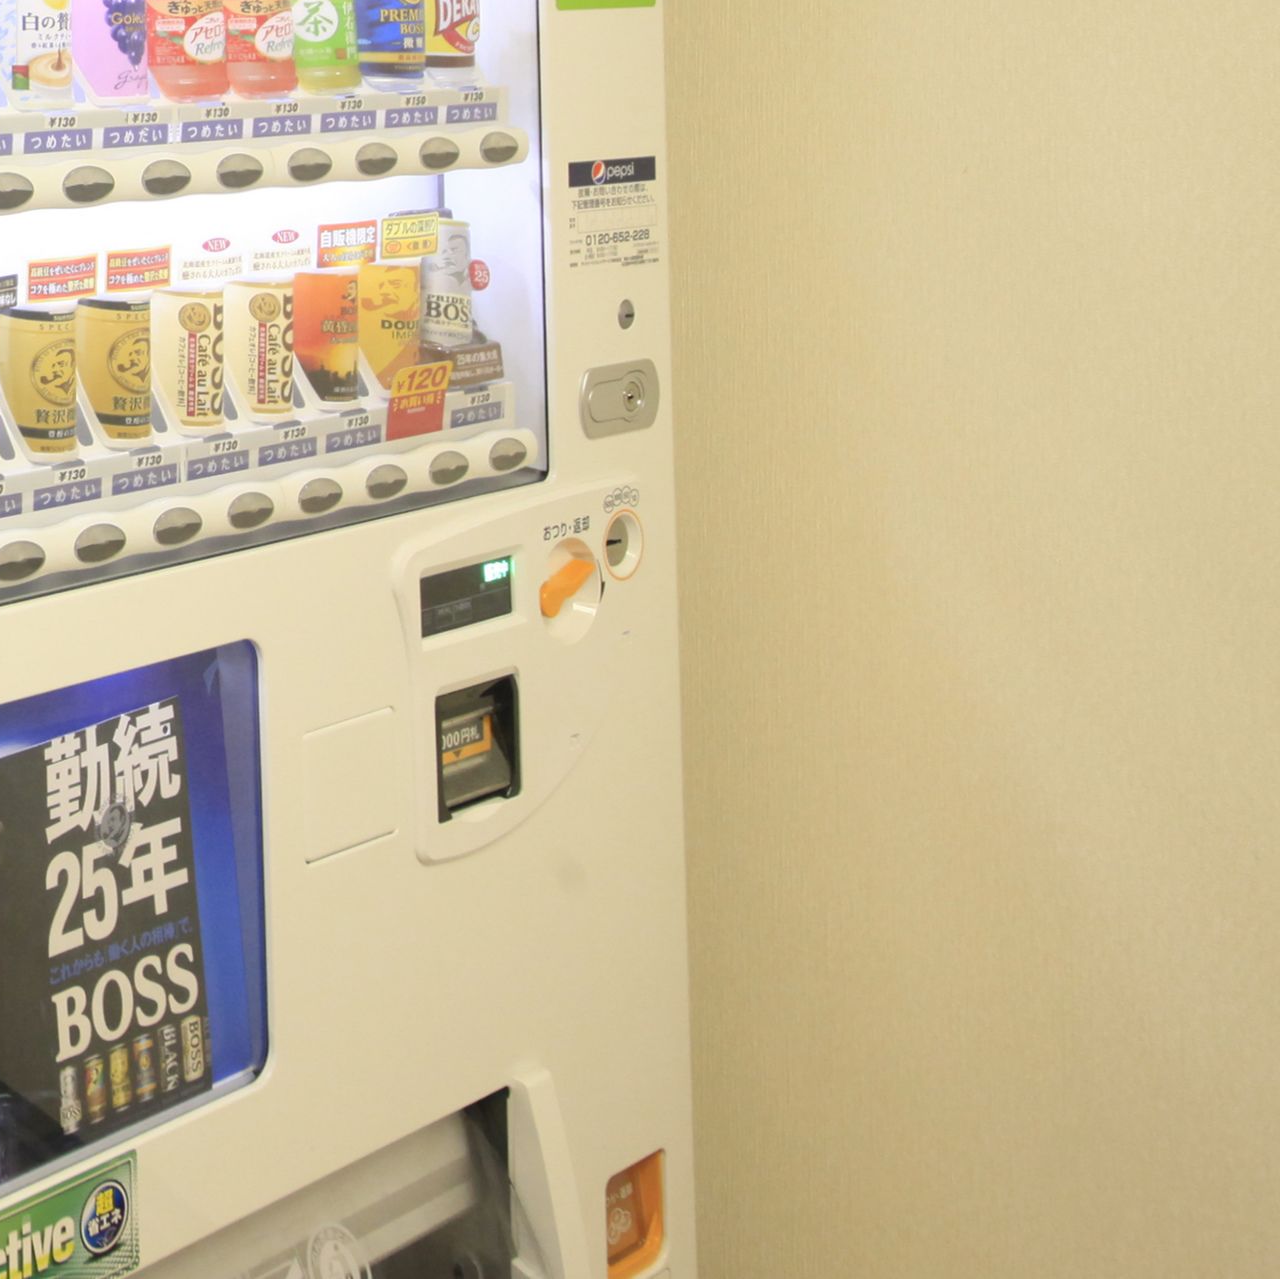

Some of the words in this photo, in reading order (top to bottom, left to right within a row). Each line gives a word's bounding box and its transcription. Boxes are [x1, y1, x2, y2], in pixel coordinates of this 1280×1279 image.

[299, 0, 334, 36] 茶
[340, 99, 363, 110] ¥130
[405, 95, 426, 106] ¥150
[205, 107, 230, 118] ¥130
[325, 113, 372, 129] つめたい
[30, 133, 87, 150] つめたい
[606, 162, 635, 181] pepsi
[207, 239, 228, 251] NEW
[277, 231, 297, 243] NEW
[320, 226, 376, 248] 自販機限定
[585, 228, 650, 247] 0120-652-228
[197, 333, 211, 366] Café
[199, 369, 209, 385] au
[397, 365, 448, 391] ¥120
[282, 427, 306, 439] ¥130
[264, 442, 313, 461] つめたい
[58, 468, 86, 482] ¥130
[39, 483, 98, 505] つめたい
[44, 700, 180, 844] 勤続
[44, 818, 189, 958] 25年
[51, 943, 199, 1063] BOSS
[189, 1020, 203, 1073] BOSS
[163, 1024, 180, 1092] BLACK
[95, 1188, 116, 1216] 超
